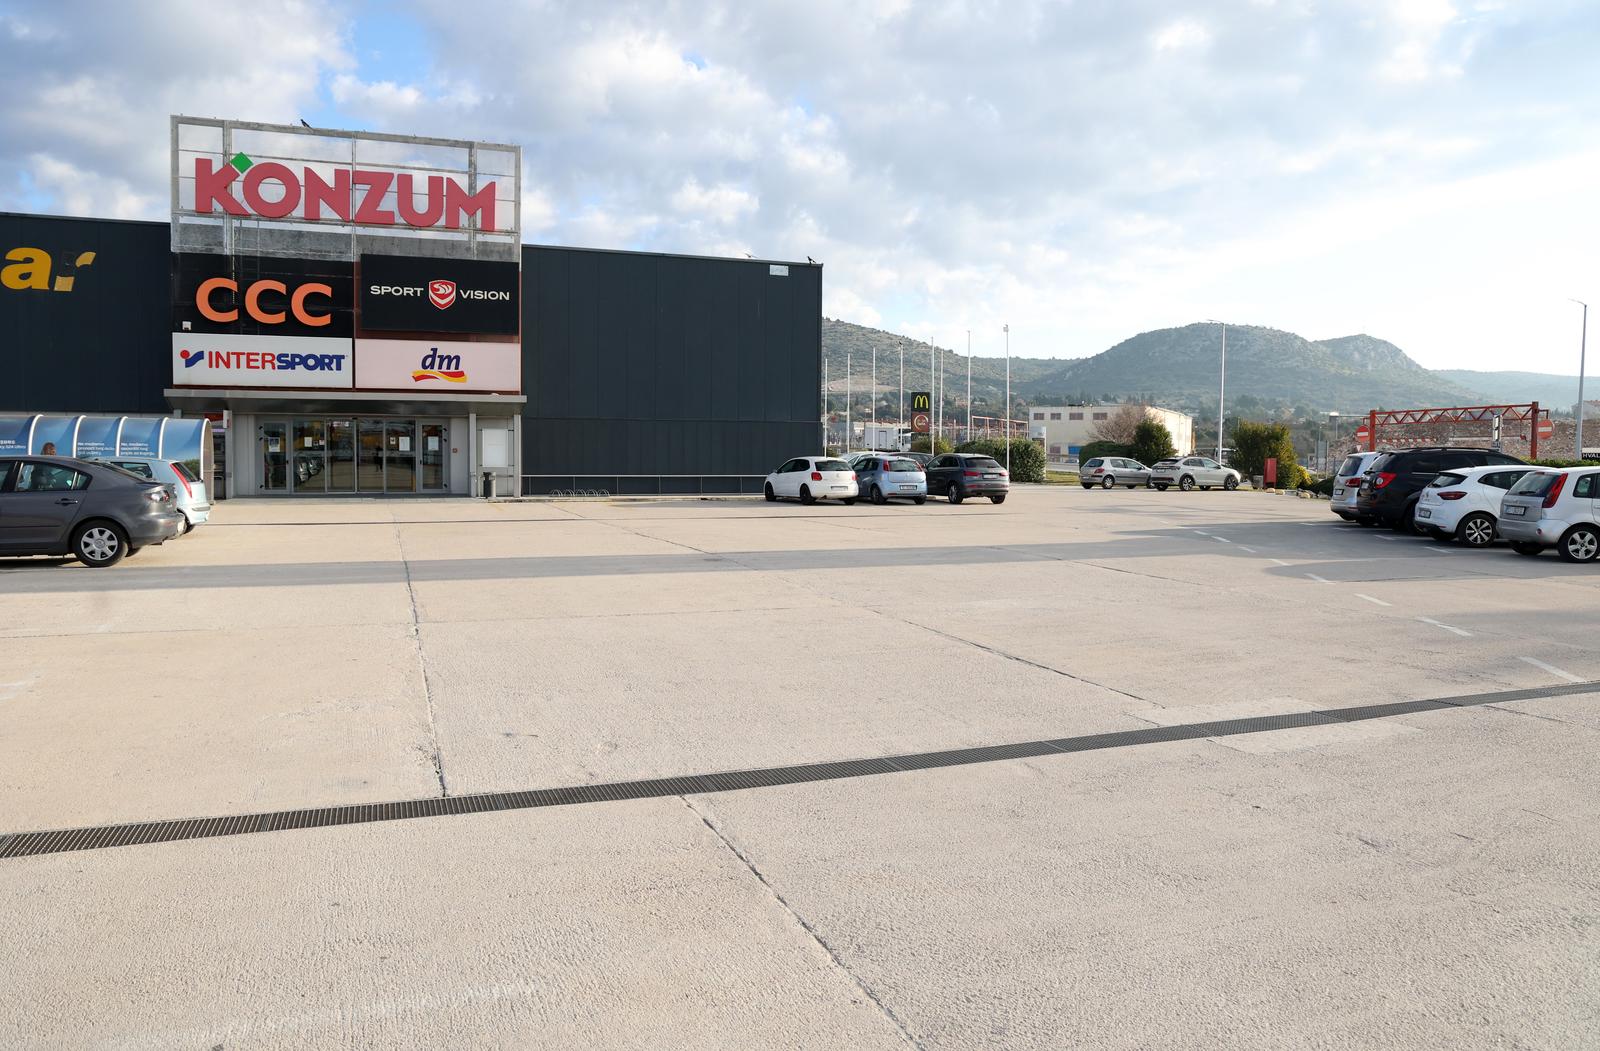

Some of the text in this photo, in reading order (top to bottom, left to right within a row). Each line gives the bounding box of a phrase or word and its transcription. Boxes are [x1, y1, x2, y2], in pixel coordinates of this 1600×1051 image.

[195, 157, 496, 232] KONZUM
[195, 277, 333, 327] CCC
[370, 285, 510, 301] SPORT VISION
[208, 350, 346, 372] INTERSPORT
[421, 347, 461, 371] dm
